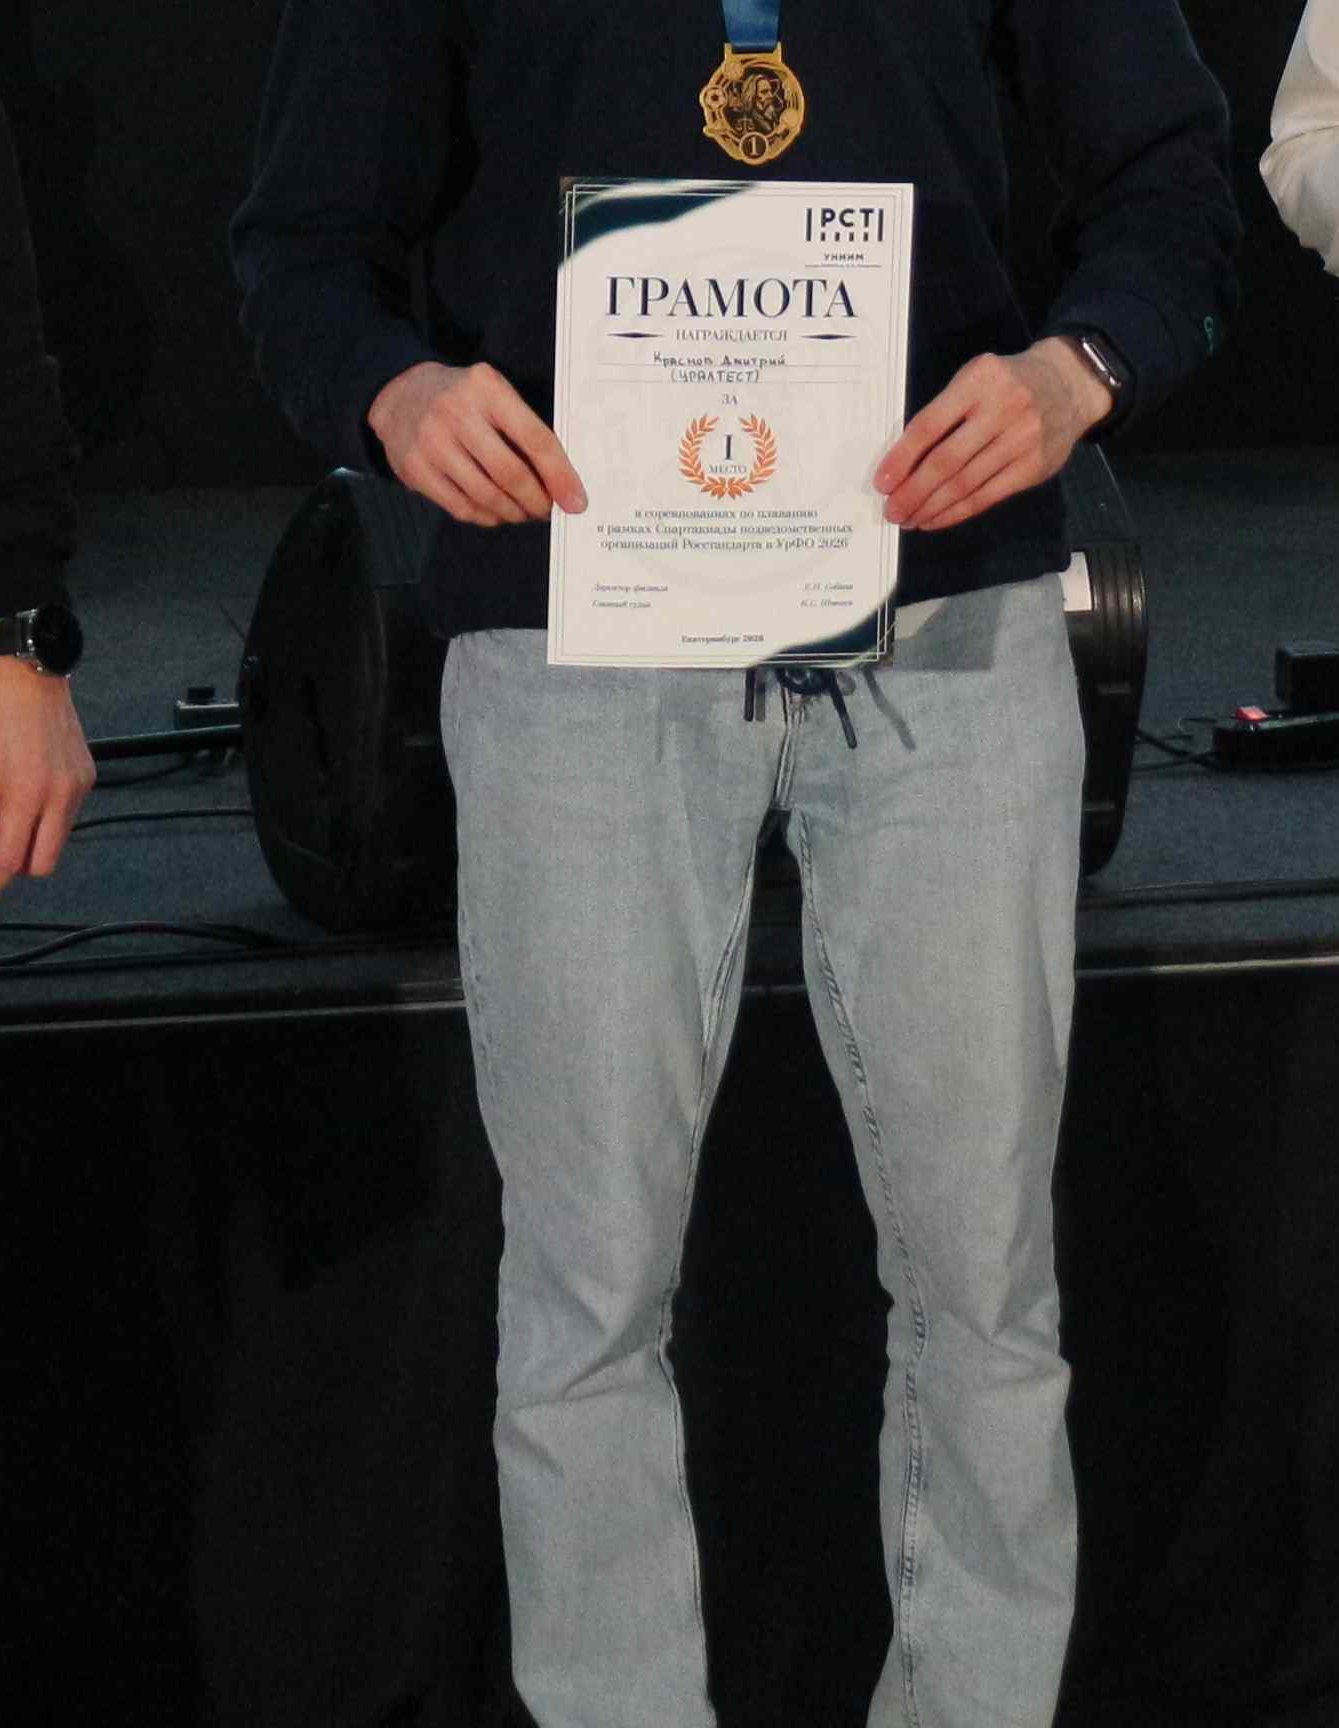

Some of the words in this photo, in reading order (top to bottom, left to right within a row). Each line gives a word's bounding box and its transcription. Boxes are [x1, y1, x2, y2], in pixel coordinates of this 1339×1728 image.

[748, 136, 759, 156] 1
[823, 252, 865, 261] УНИИМ
[605, 276, 859, 318] ГРАМОТА
[675, 329, 789, 343] НАГРАЖДАЕТСЯ
[721, 353, 787, 370] Дмитрий
[670, 370, 761, 384] (УРАЛТЕСТ)
[721, 393, 739, 405] ЗА
[709, 464, 747, 474] МЕСТО
[775, 538, 816, 552] УрФО
[818, 538, 850, 549] 2026
